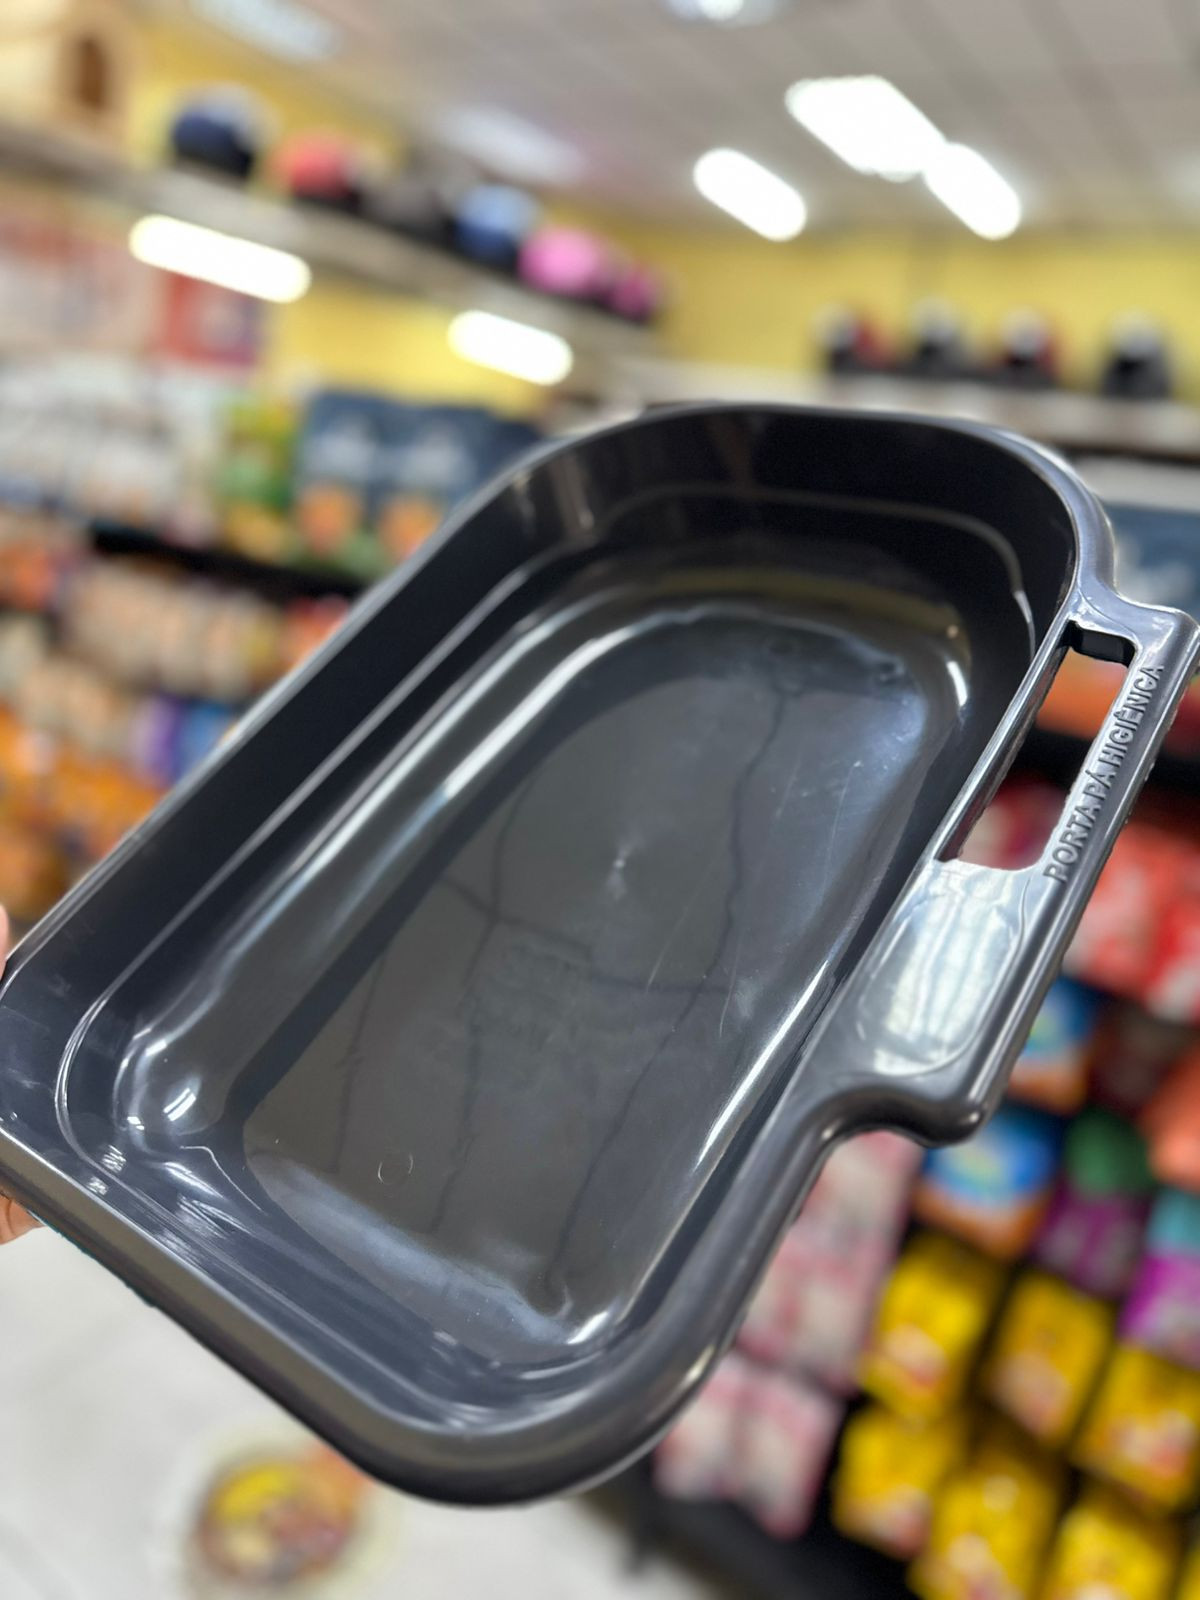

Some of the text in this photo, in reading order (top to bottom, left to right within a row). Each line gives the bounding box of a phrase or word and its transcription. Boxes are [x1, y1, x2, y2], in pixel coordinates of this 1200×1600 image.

[1043, 665, 1165, 883] PORTA PÁ HIGIÊNICA
